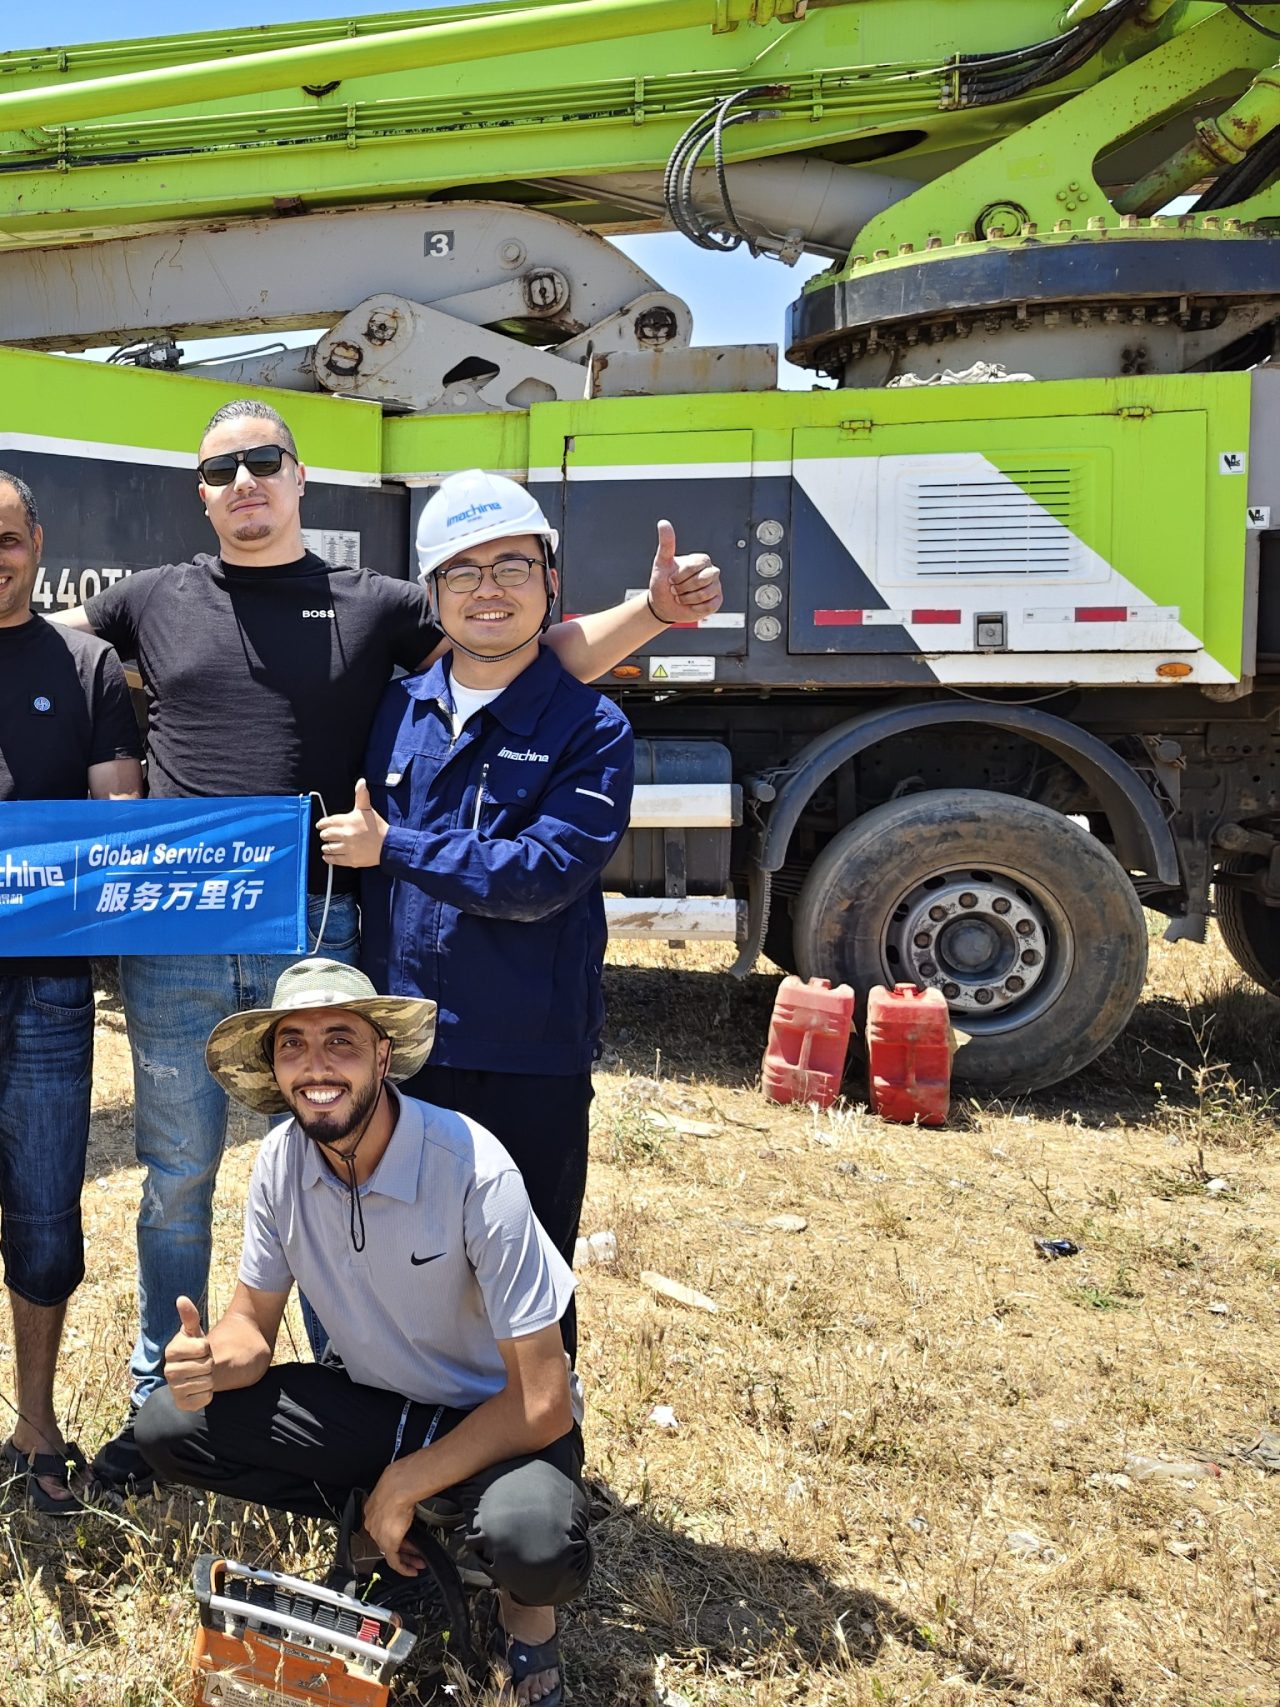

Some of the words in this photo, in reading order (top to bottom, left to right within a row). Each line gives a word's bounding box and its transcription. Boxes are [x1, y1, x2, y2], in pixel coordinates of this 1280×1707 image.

[429, 233, 450, 257] 3
[32, 566, 132, 610] 440T
[302, 609, 336, 619] BOSS
[497, 746, 550, 763] imachine
[88, 843, 151, 867] Global
[152, 842, 227, 865] Service
[231, 840, 276, 863] Tour
[95, 879, 266, 913] 服务万里行
